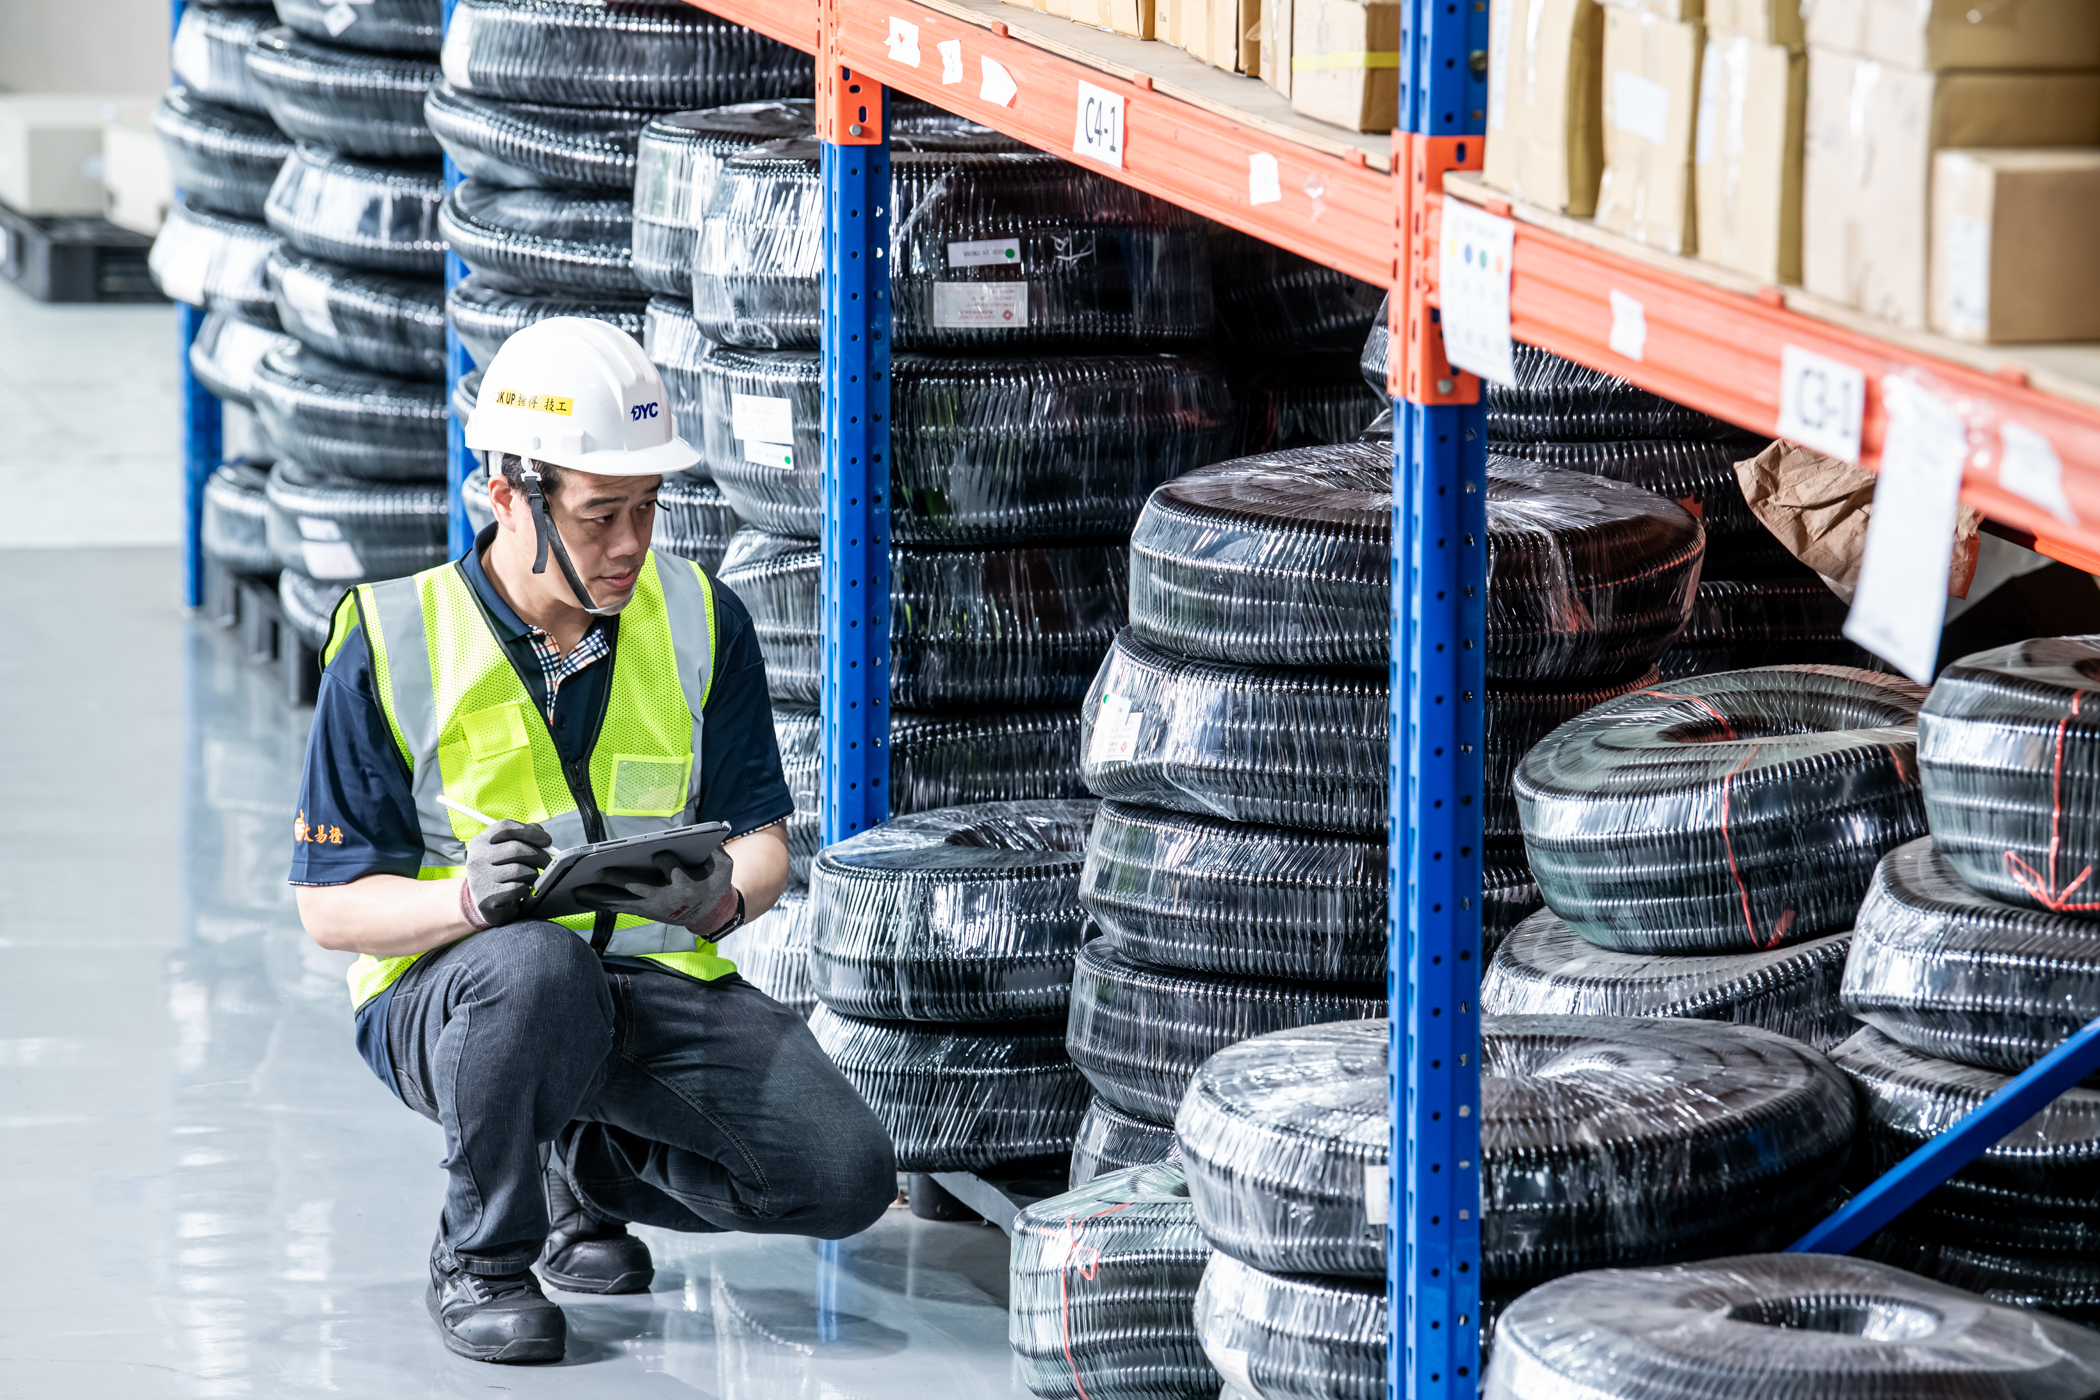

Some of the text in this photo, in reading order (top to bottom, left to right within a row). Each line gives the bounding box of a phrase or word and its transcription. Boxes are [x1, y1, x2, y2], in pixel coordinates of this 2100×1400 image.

[1085, 97, 1116, 153] C4-1
[506, 392, 516, 405] UP
[544, 398, 567, 412] 技工
[631, 402, 659, 422] DYC
[1795, 366, 1852, 437] C3-1
